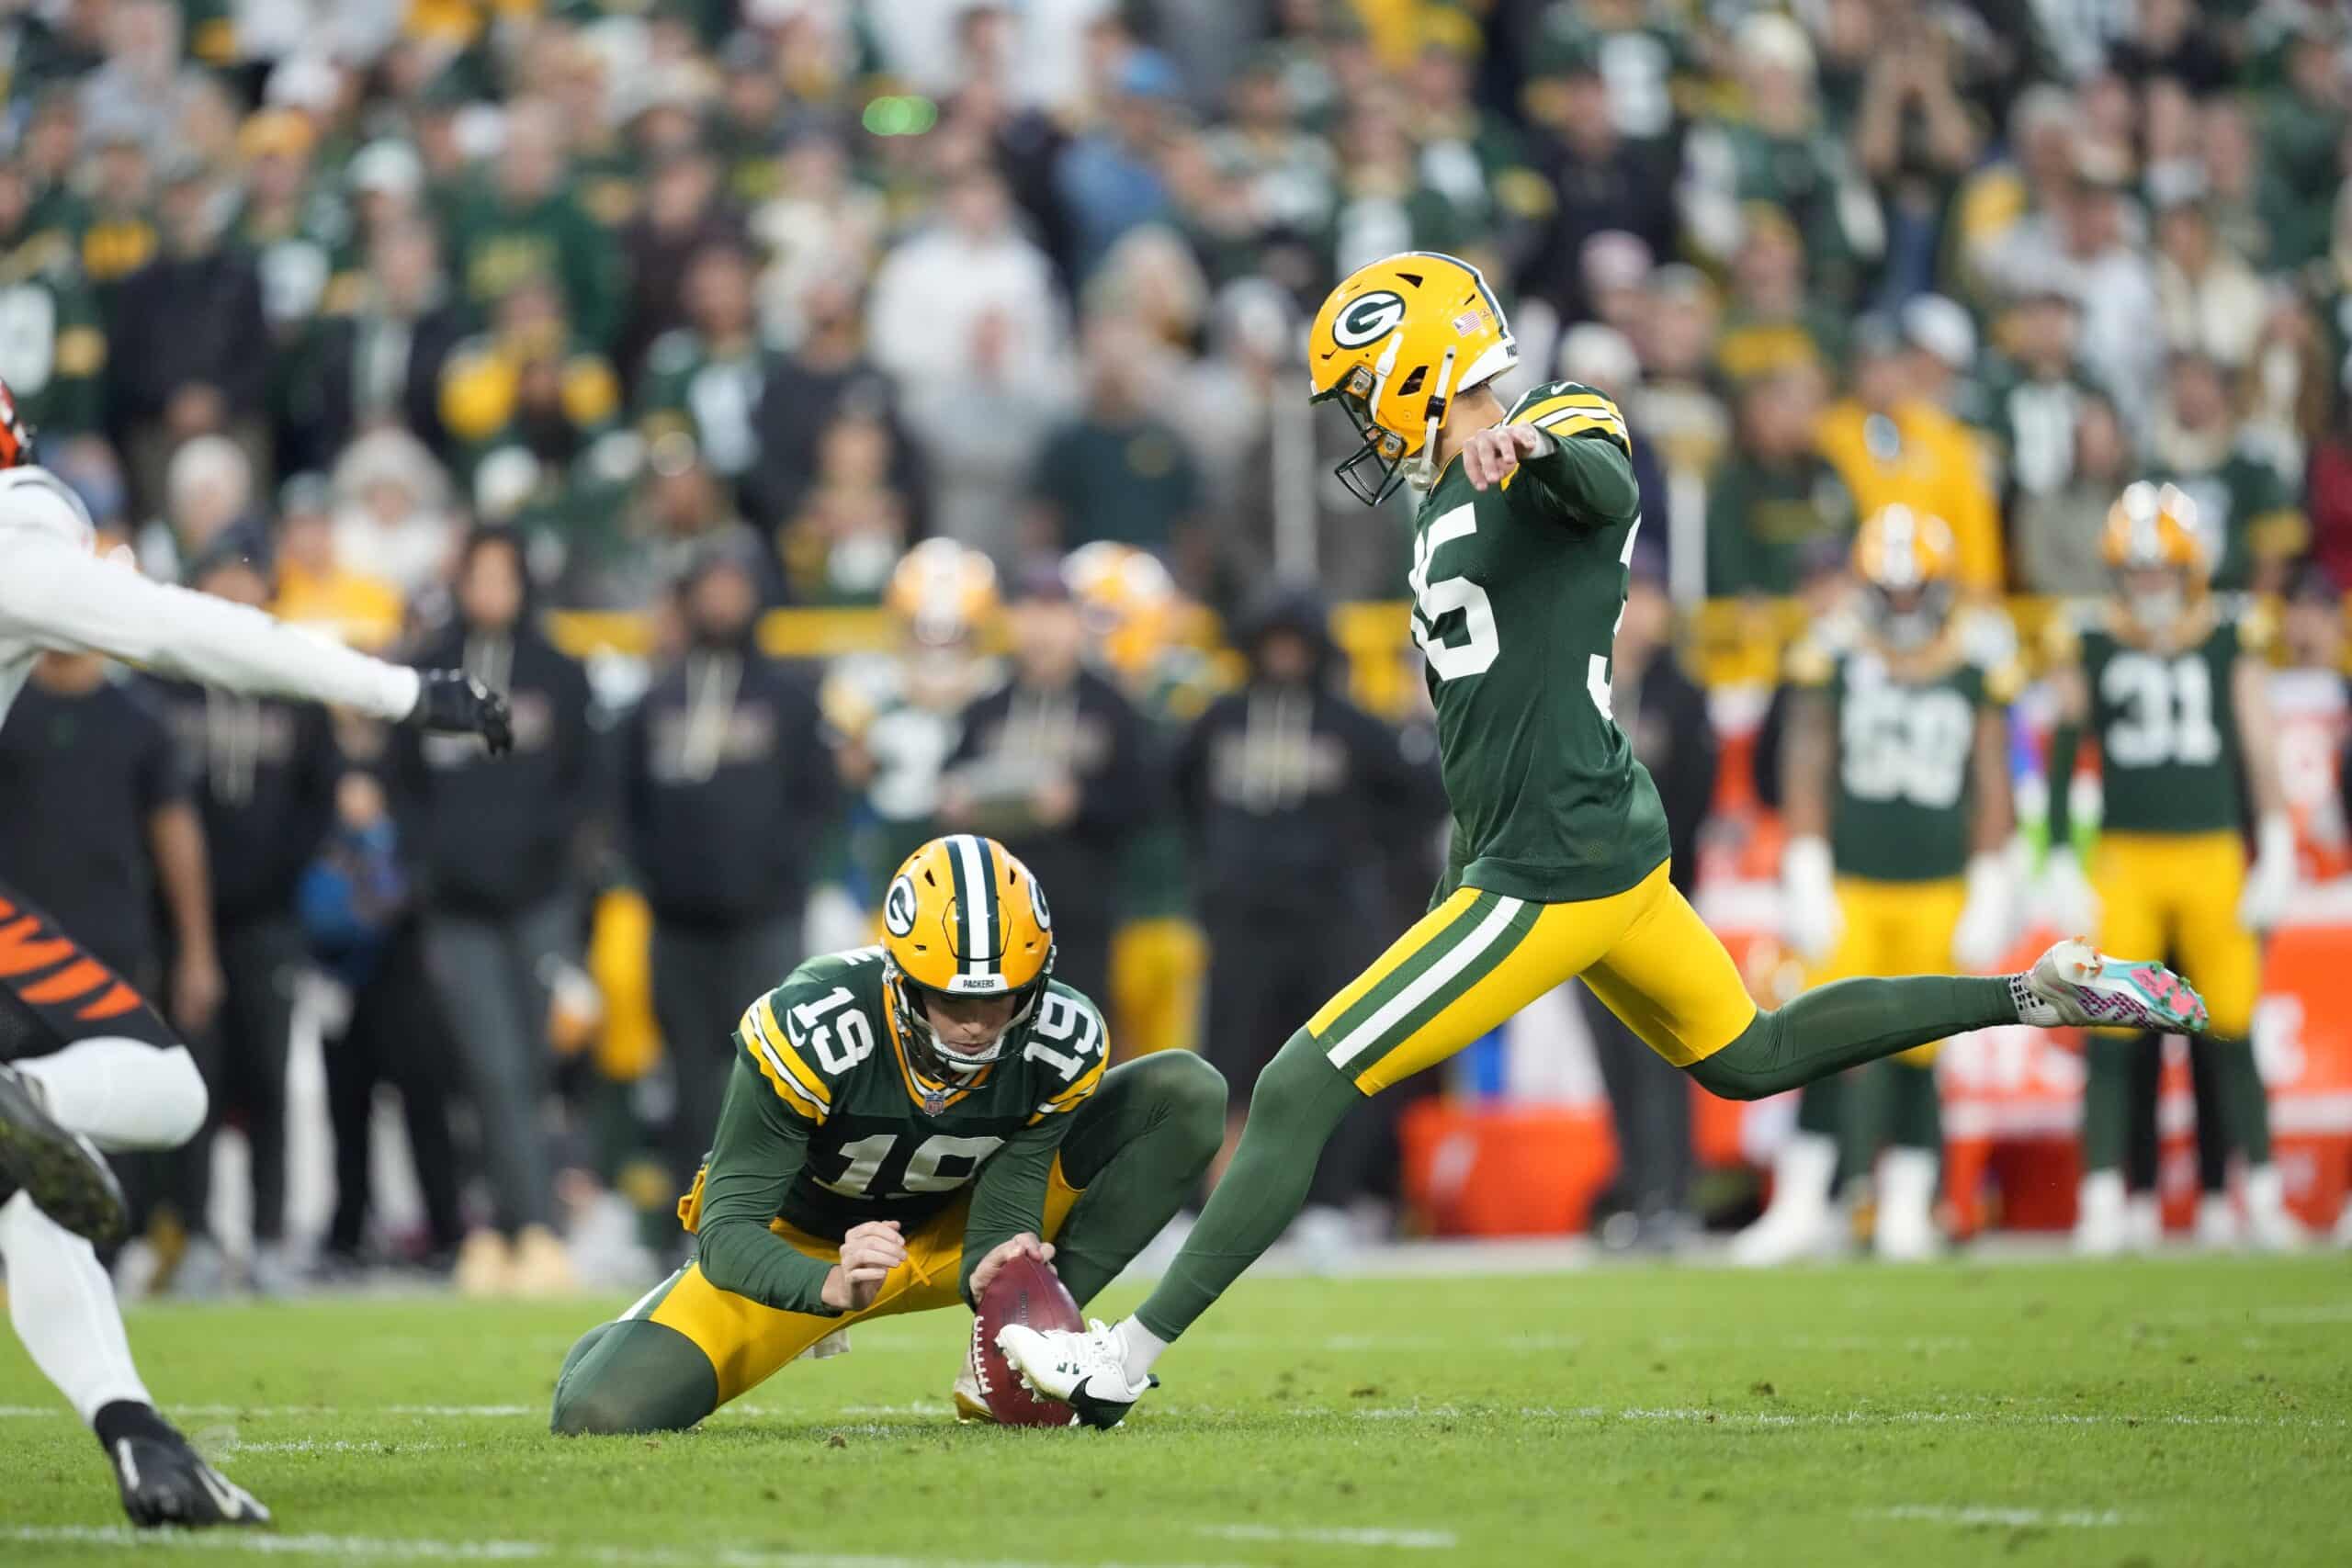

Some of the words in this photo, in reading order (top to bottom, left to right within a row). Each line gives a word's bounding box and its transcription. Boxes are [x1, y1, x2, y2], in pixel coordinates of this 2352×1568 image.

[1333, 291, 1403, 347] G
[2100, 651, 2222, 768] 31
[885, 874, 917, 936] G
[963, 979, 995, 988] PACKERS
[792, 987, 875, 1076] 19
[1023, 992, 1100, 1082] 19
